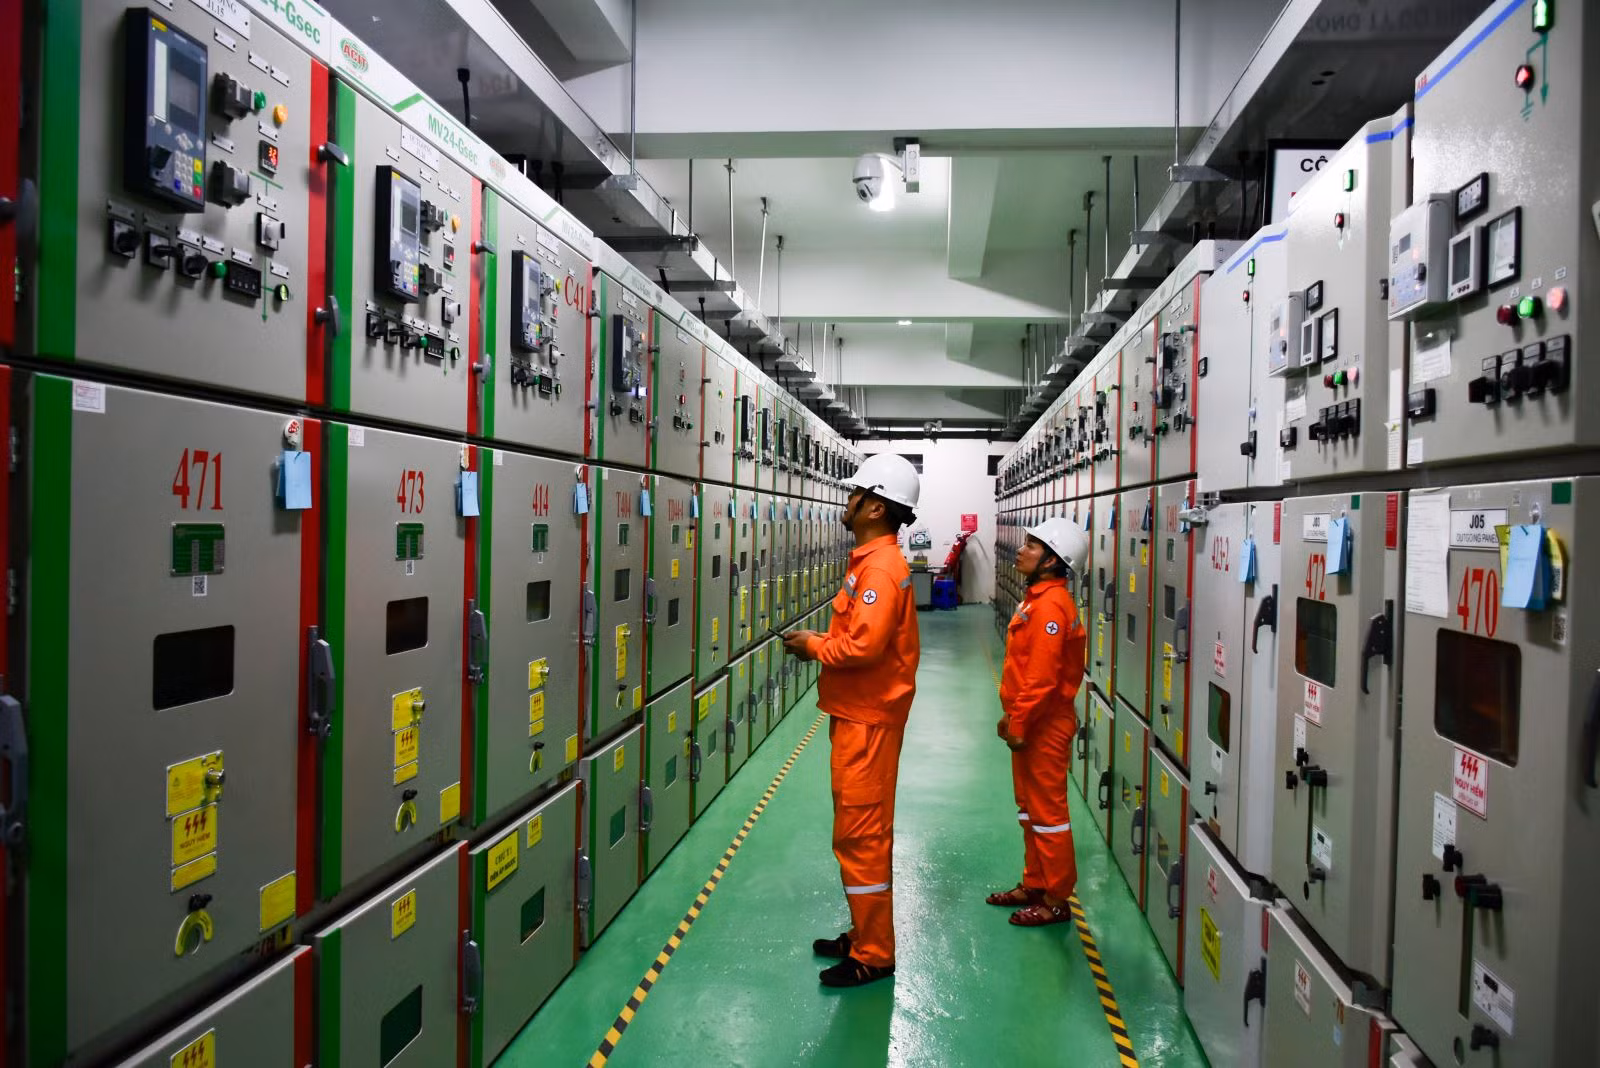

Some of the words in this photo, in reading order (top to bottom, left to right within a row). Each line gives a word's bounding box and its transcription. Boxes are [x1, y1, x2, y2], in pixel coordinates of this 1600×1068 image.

[428, 112, 478, 166] MV24-Gsec
[564, 275, 587, 315] C41
[172, 448, 224, 511] 471
[396, 469, 425, 514] 473
[532, 483, 550, 516] 414
[1456, 533, 1482, 543] OUTGOING
[1469, 514, 1485, 529] J05
[1305, 552, 1327, 601] 472
[1456, 567, 1499, 639] 470
